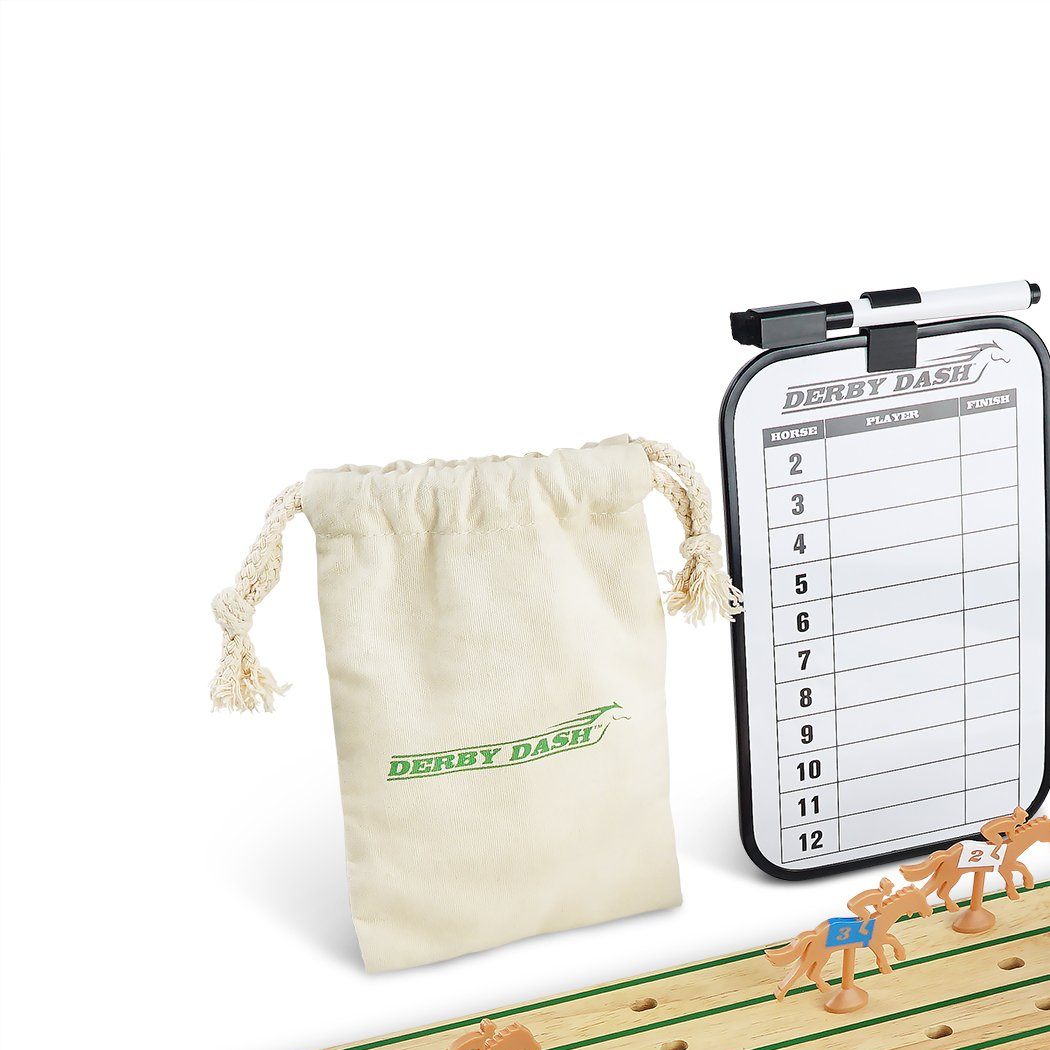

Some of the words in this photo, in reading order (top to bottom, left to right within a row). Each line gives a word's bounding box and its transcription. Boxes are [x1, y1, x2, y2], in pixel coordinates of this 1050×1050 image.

[782, 376, 887, 410] DERBY
[770, 426, 818, 442] HORSE
[865, 409, 920, 426] PLAYER
[966, 394, 1010, 410] FINISH
[789, 453, 803, 476] 2
[791, 494, 804, 516] 3
[793, 533, 807, 555] 4
[795, 574, 808, 595] 5
[796, 612, 810, 633] 6
[798, 650, 811, 671] 7
[800, 688, 812, 708] 8
[801, 724, 813, 745] 9
[387, 747, 502, 777] DERBY
[797, 759, 821, 782] 10
[798, 795, 820, 817] 11
[799, 830, 823, 852] 12
[969, 849, 984, 863] 2
[836, 926, 851, 941] 3
